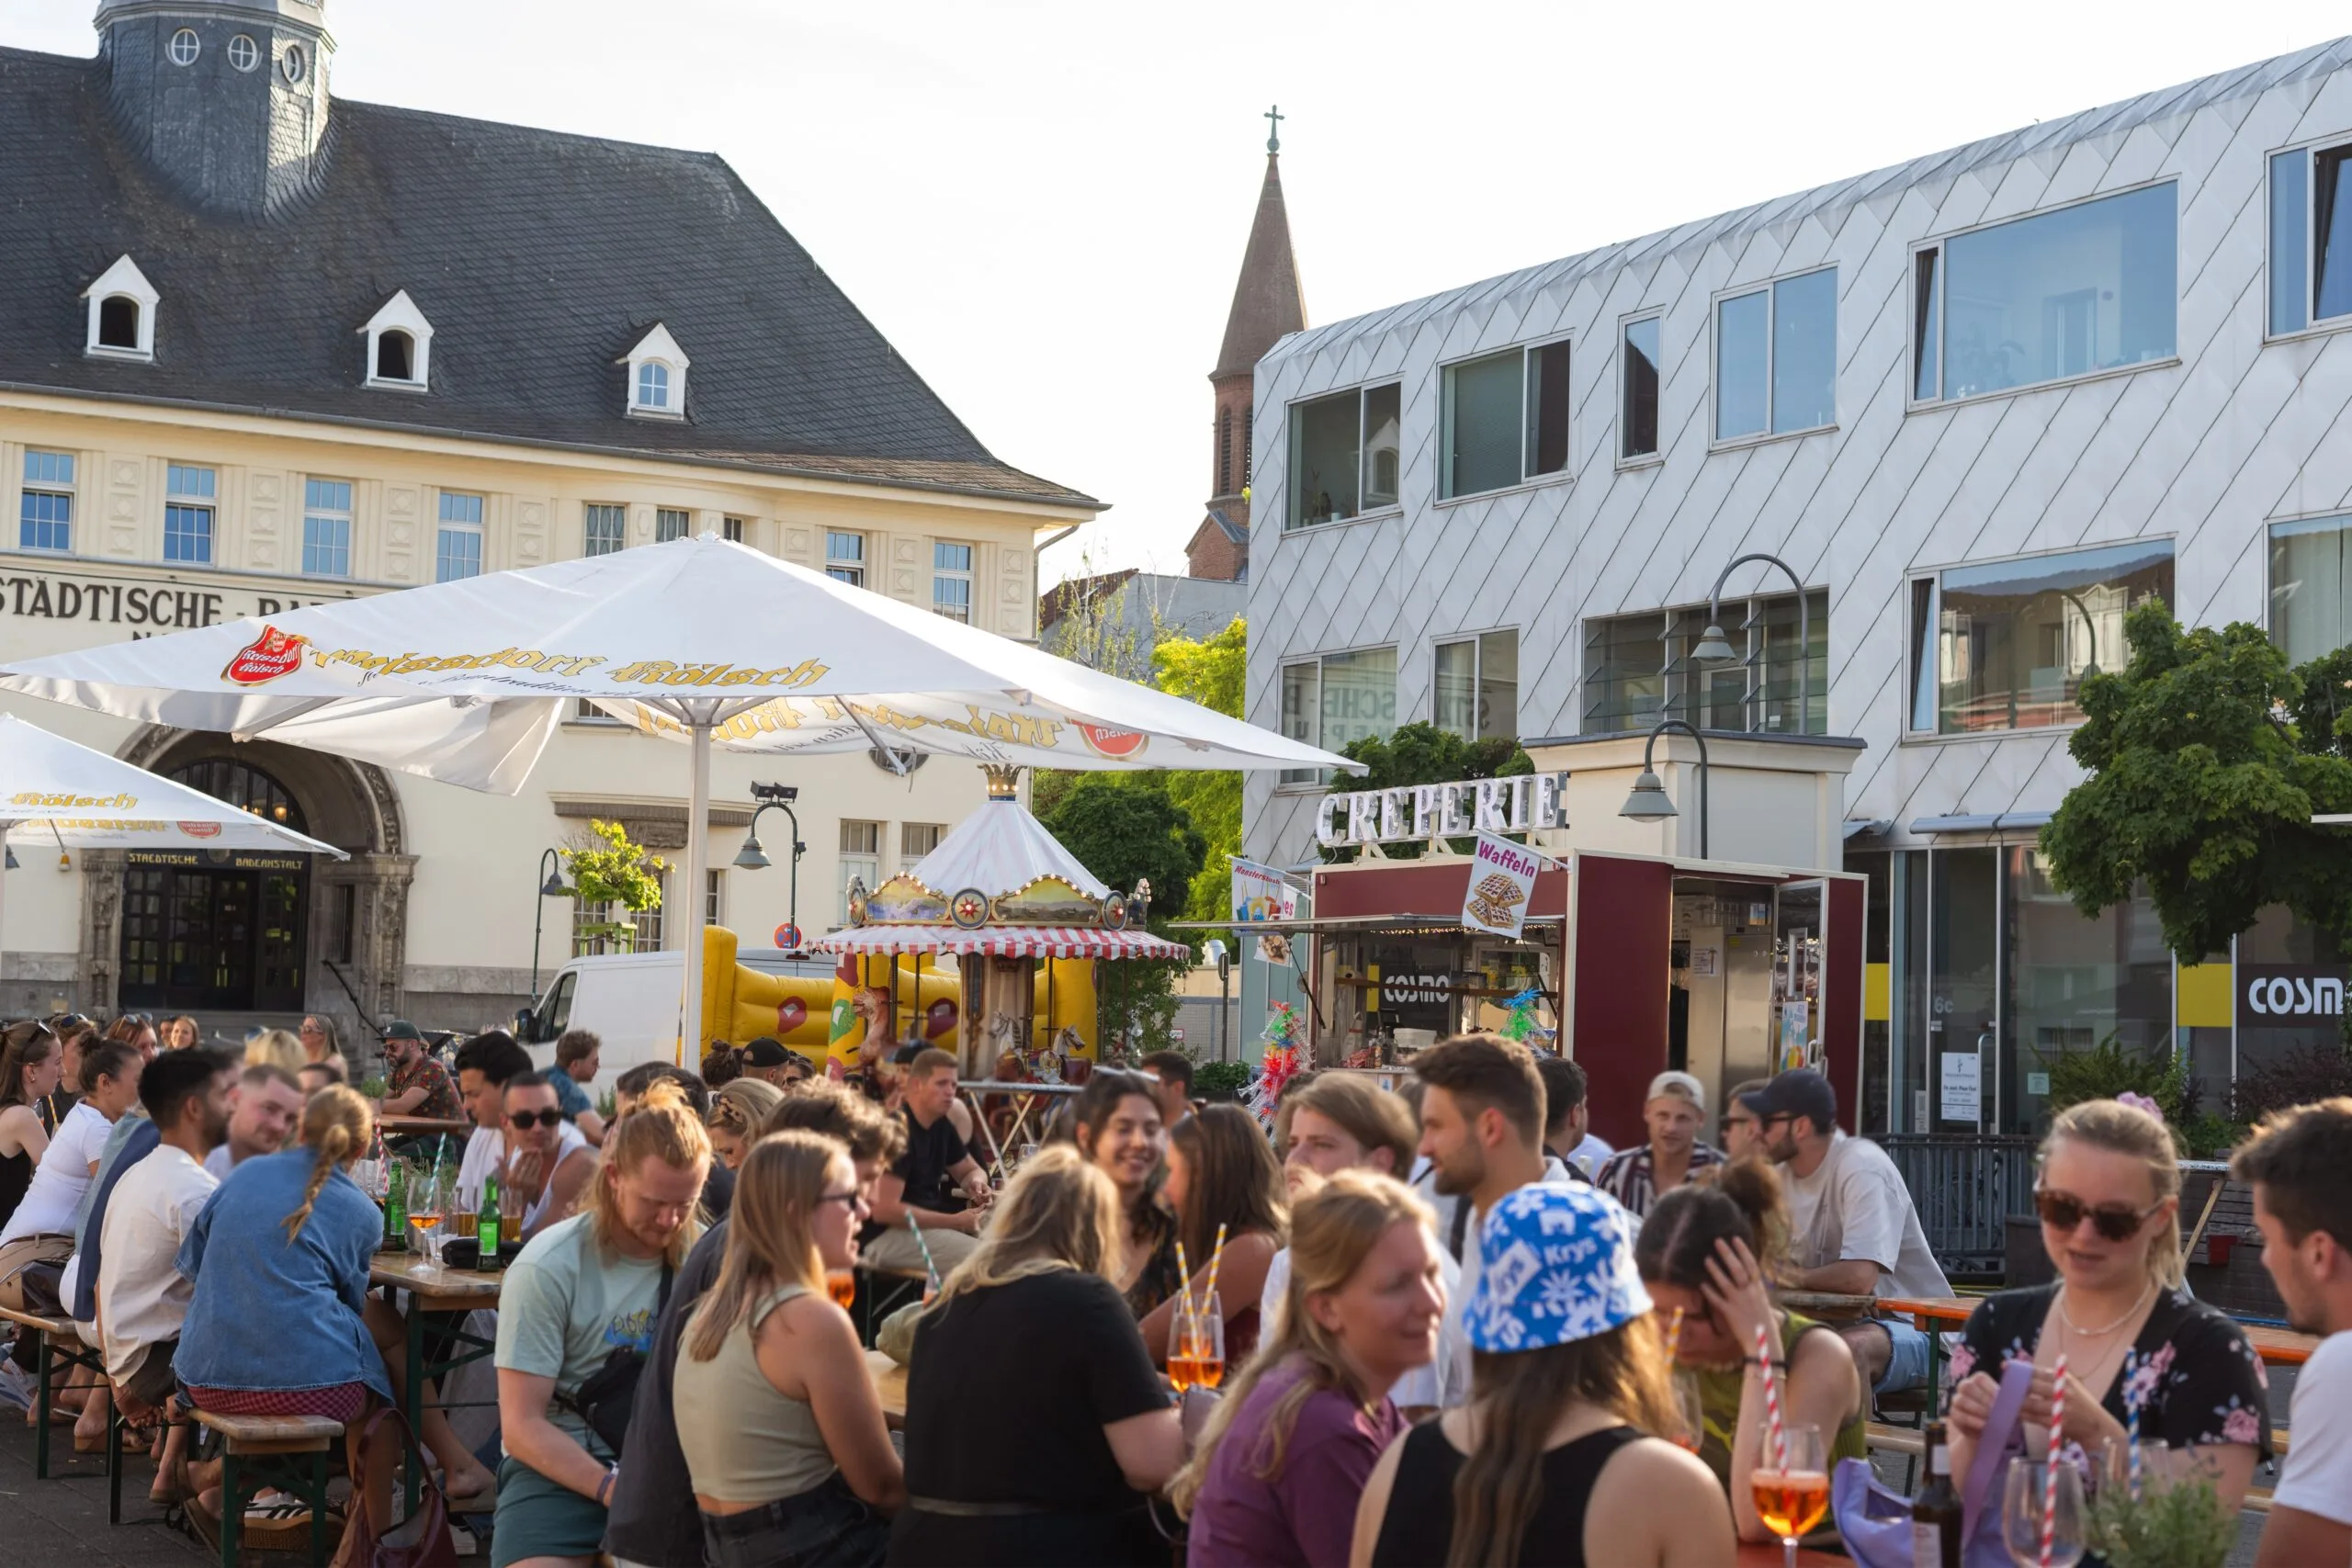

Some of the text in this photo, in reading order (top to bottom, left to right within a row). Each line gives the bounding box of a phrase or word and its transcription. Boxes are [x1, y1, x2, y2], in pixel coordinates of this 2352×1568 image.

[0, 576, 223, 628] TÄDTISCHE
[606, 658, 831, 689] Kölsch
[1316, 773, 1564, 848] CREPERIE
[235, 858, 303, 870] BADEANSTALT
[1478, 840, 1535, 878] Waffeln
[1934, 996, 1954, 1014] 6c
[1544, 1236, 1598, 1267] Krys
